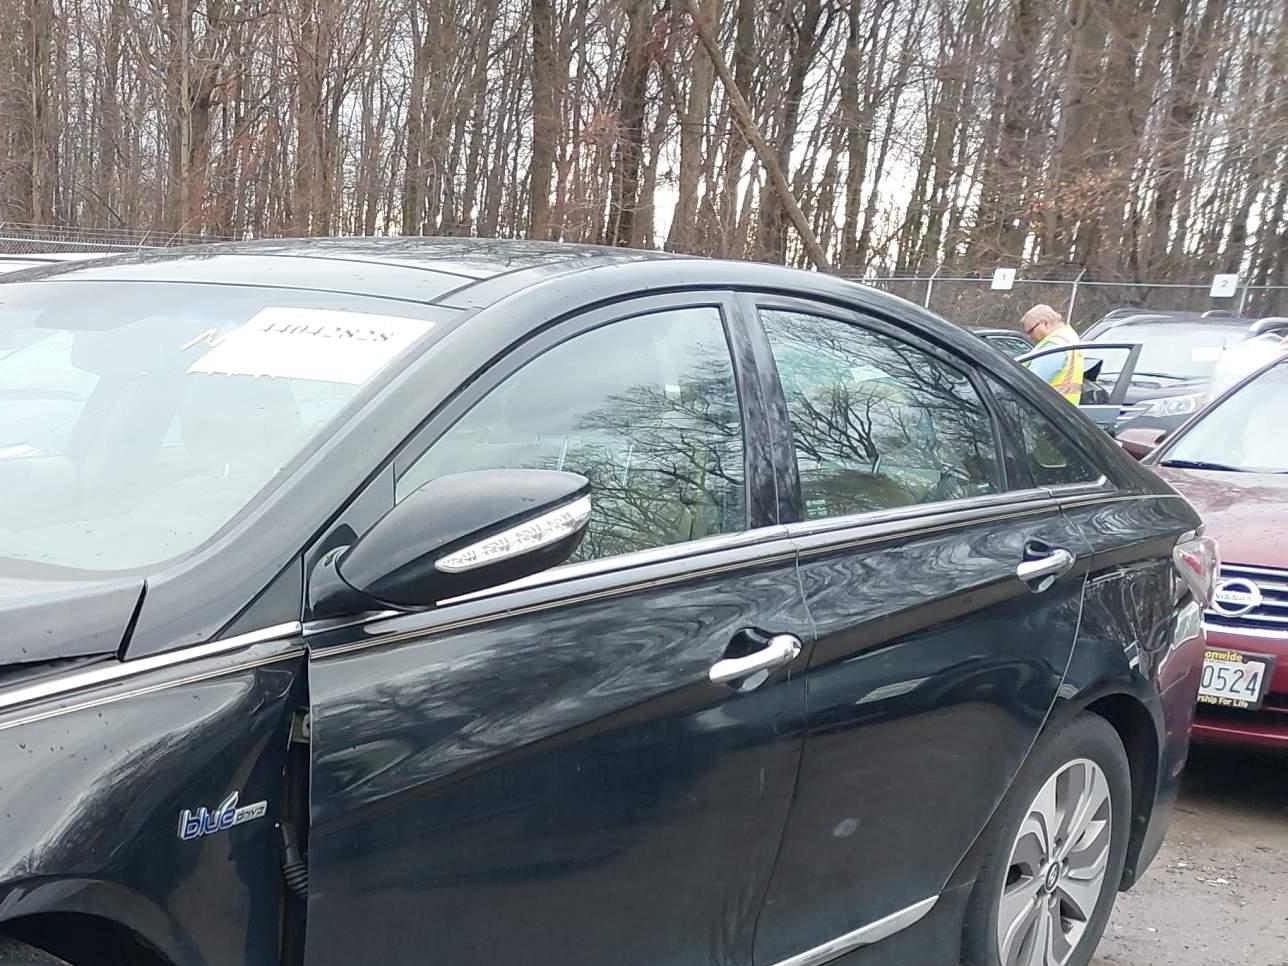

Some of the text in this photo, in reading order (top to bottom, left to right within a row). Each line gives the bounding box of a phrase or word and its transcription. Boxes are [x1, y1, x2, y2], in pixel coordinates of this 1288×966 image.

[261, 322, 394, 343] 44042828
[1215, 591, 1254, 602] NISSAN
[1201, 664, 1259, 697] 0524
[1218, 697, 1231, 706] For
[1233, 699, 1249, 709] Life
[179, 805, 266, 840] blue drive
